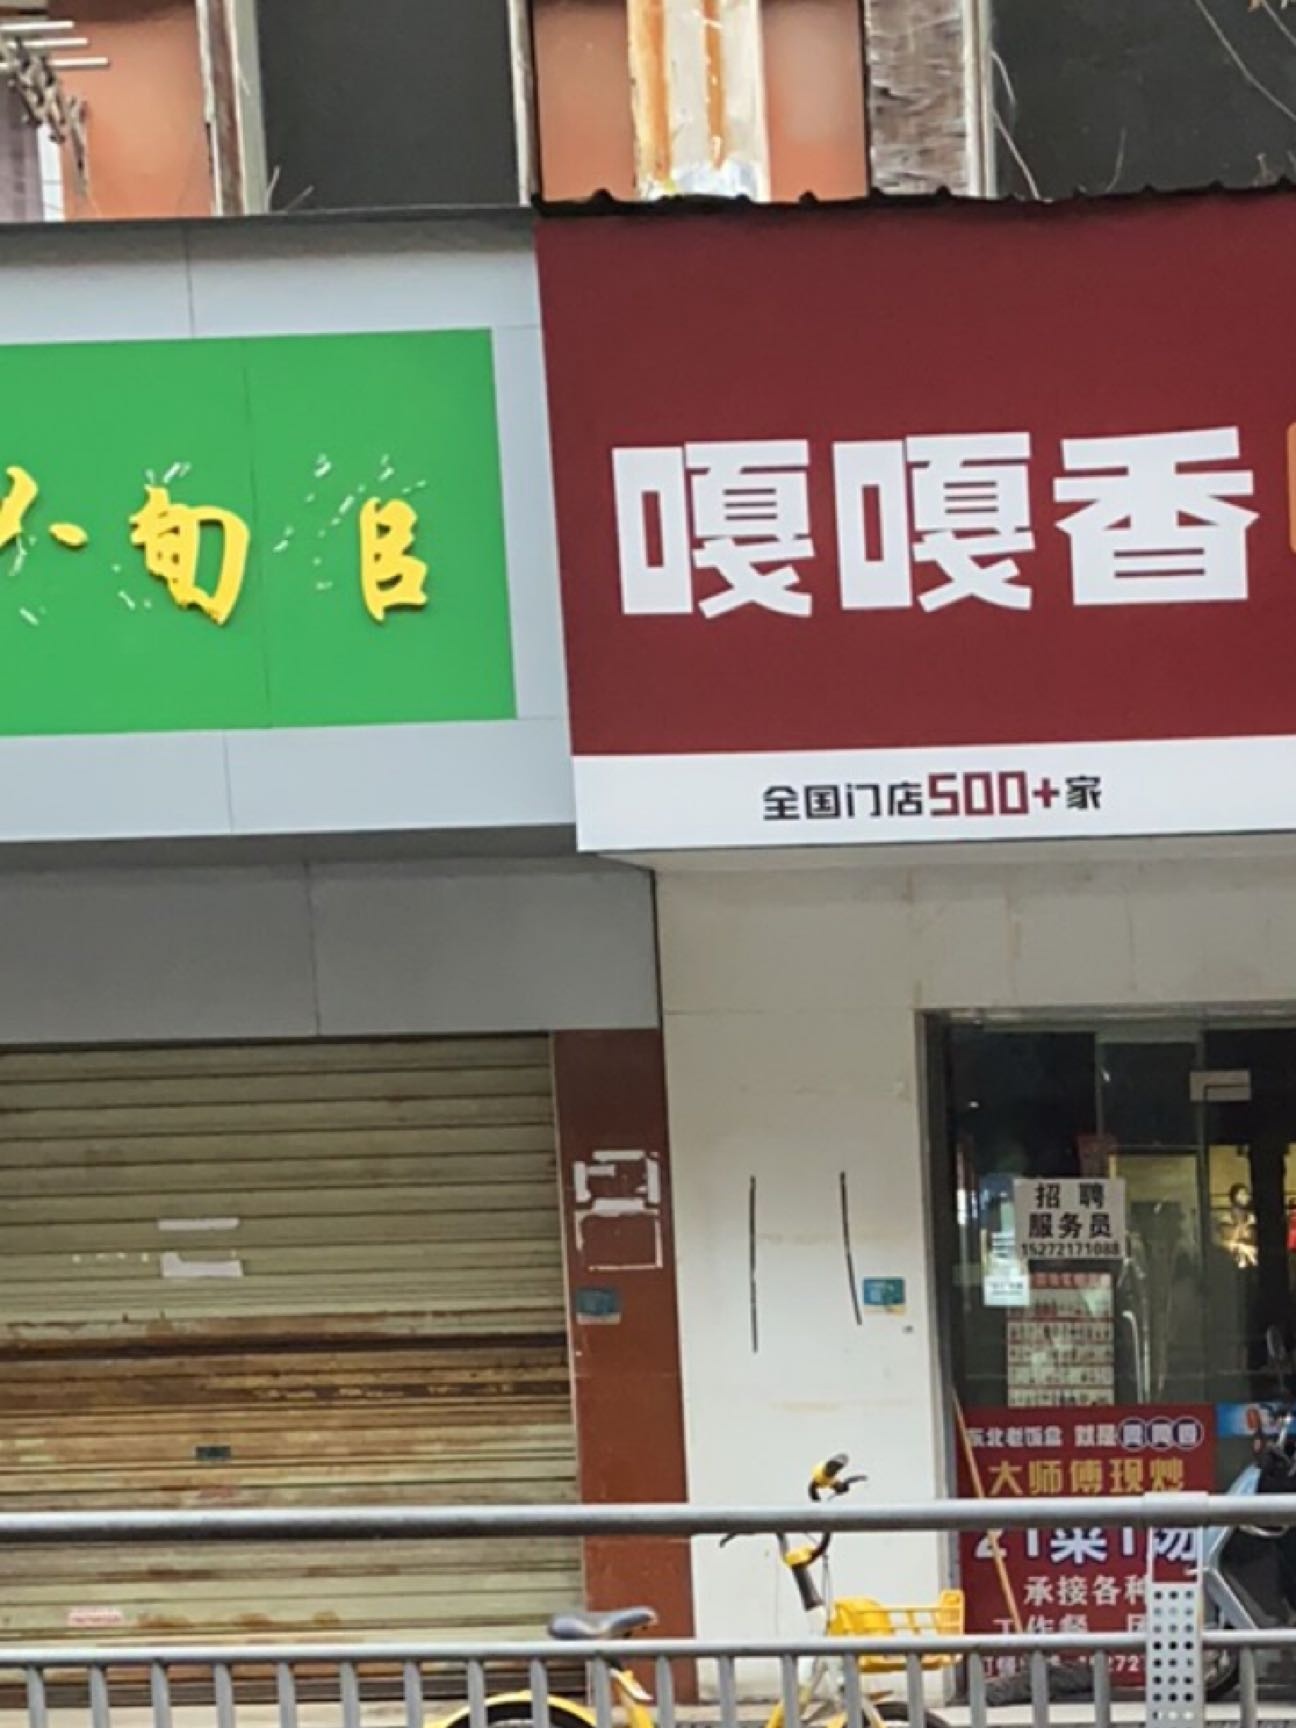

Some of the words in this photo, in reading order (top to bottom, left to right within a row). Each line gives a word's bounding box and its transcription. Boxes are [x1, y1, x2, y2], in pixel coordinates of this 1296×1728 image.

[611, 426, 1259, 618] 嘎嘎香
[762, 770, 1102, 821] 全国门店500+家
[1034, 1182, 1104, 1208] 招聘
[1028, 1212, 1111, 1239] 服务员
[989, 1457, 1184, 1496] 大师傅现炒
